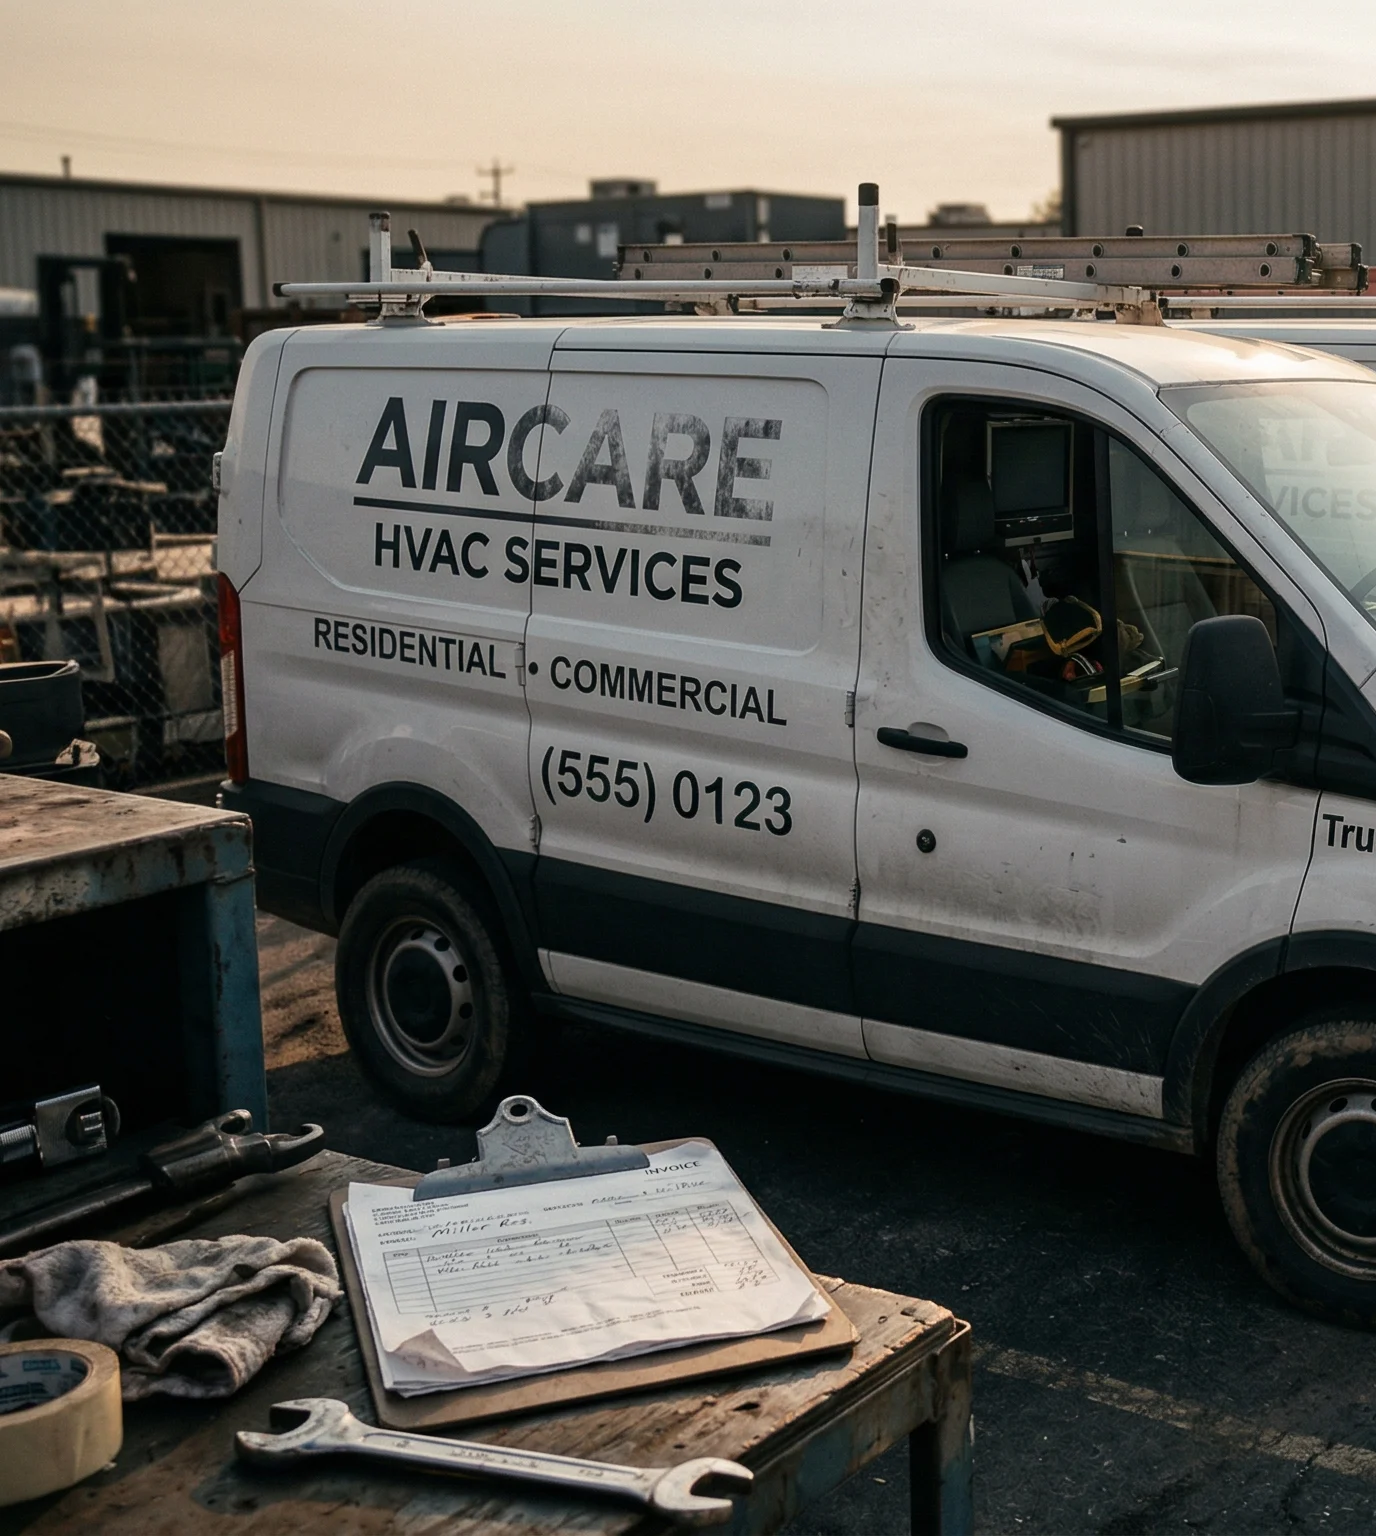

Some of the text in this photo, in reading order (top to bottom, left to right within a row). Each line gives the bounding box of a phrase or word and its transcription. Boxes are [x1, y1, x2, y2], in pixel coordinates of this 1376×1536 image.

[355, 396, 783, 522] AIRCARE
[373, 522, 744, 608] HVAC SERVICES
[313, 617, 788, 727] RESIDENTIAL COMMERCIAL
[541, 745, 793, 837] (555) 0123
[644, 1159, 702, 1176] INVOICE
